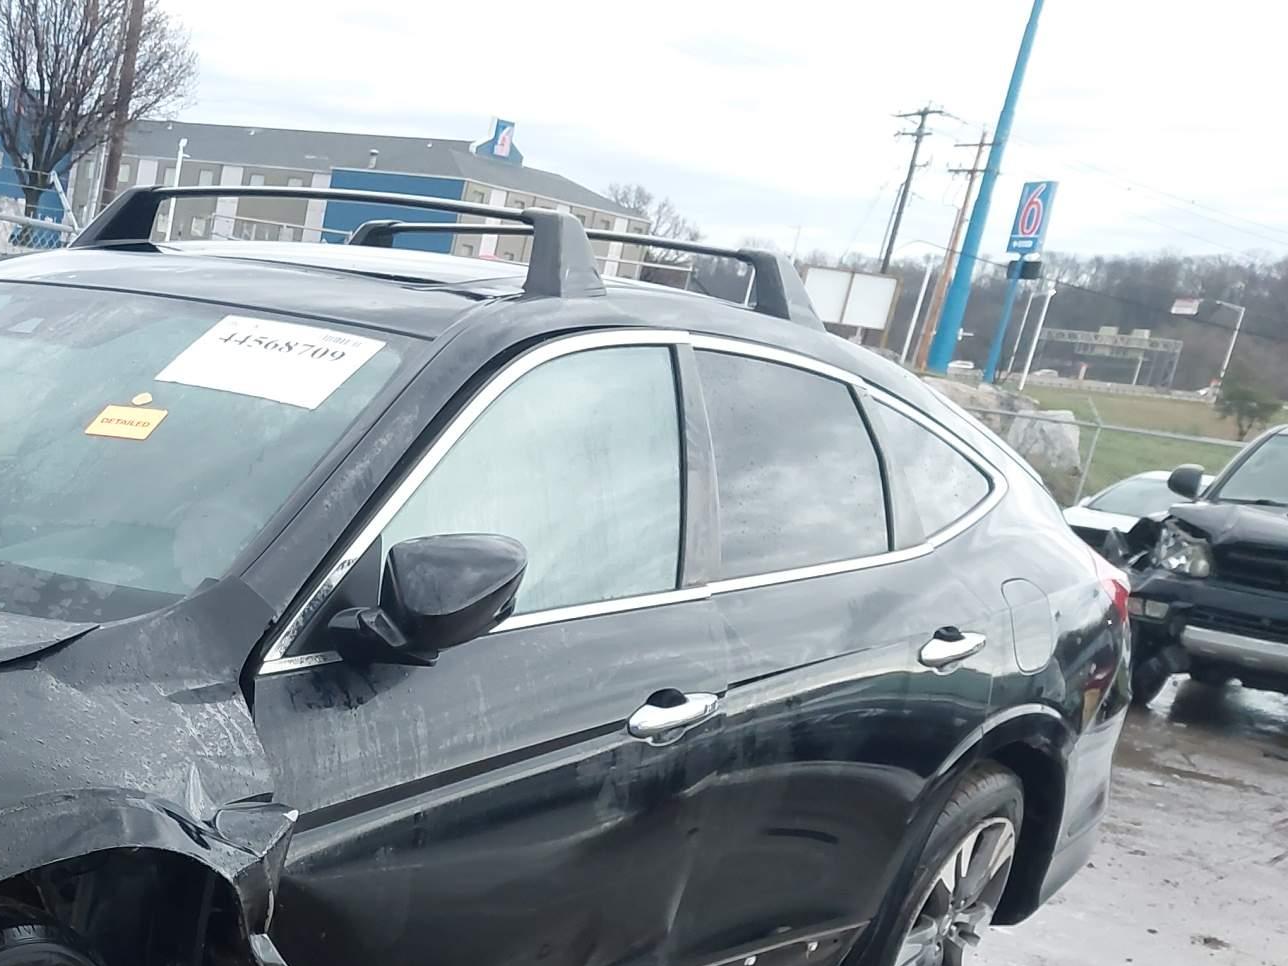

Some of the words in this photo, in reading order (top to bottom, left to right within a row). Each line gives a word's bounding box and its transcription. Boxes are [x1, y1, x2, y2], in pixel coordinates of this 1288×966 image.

[1018, 183, 1047, 237] 6
[219, 332, 346, 362] 44568709
[100, 417, 151, 428] DETAILED
